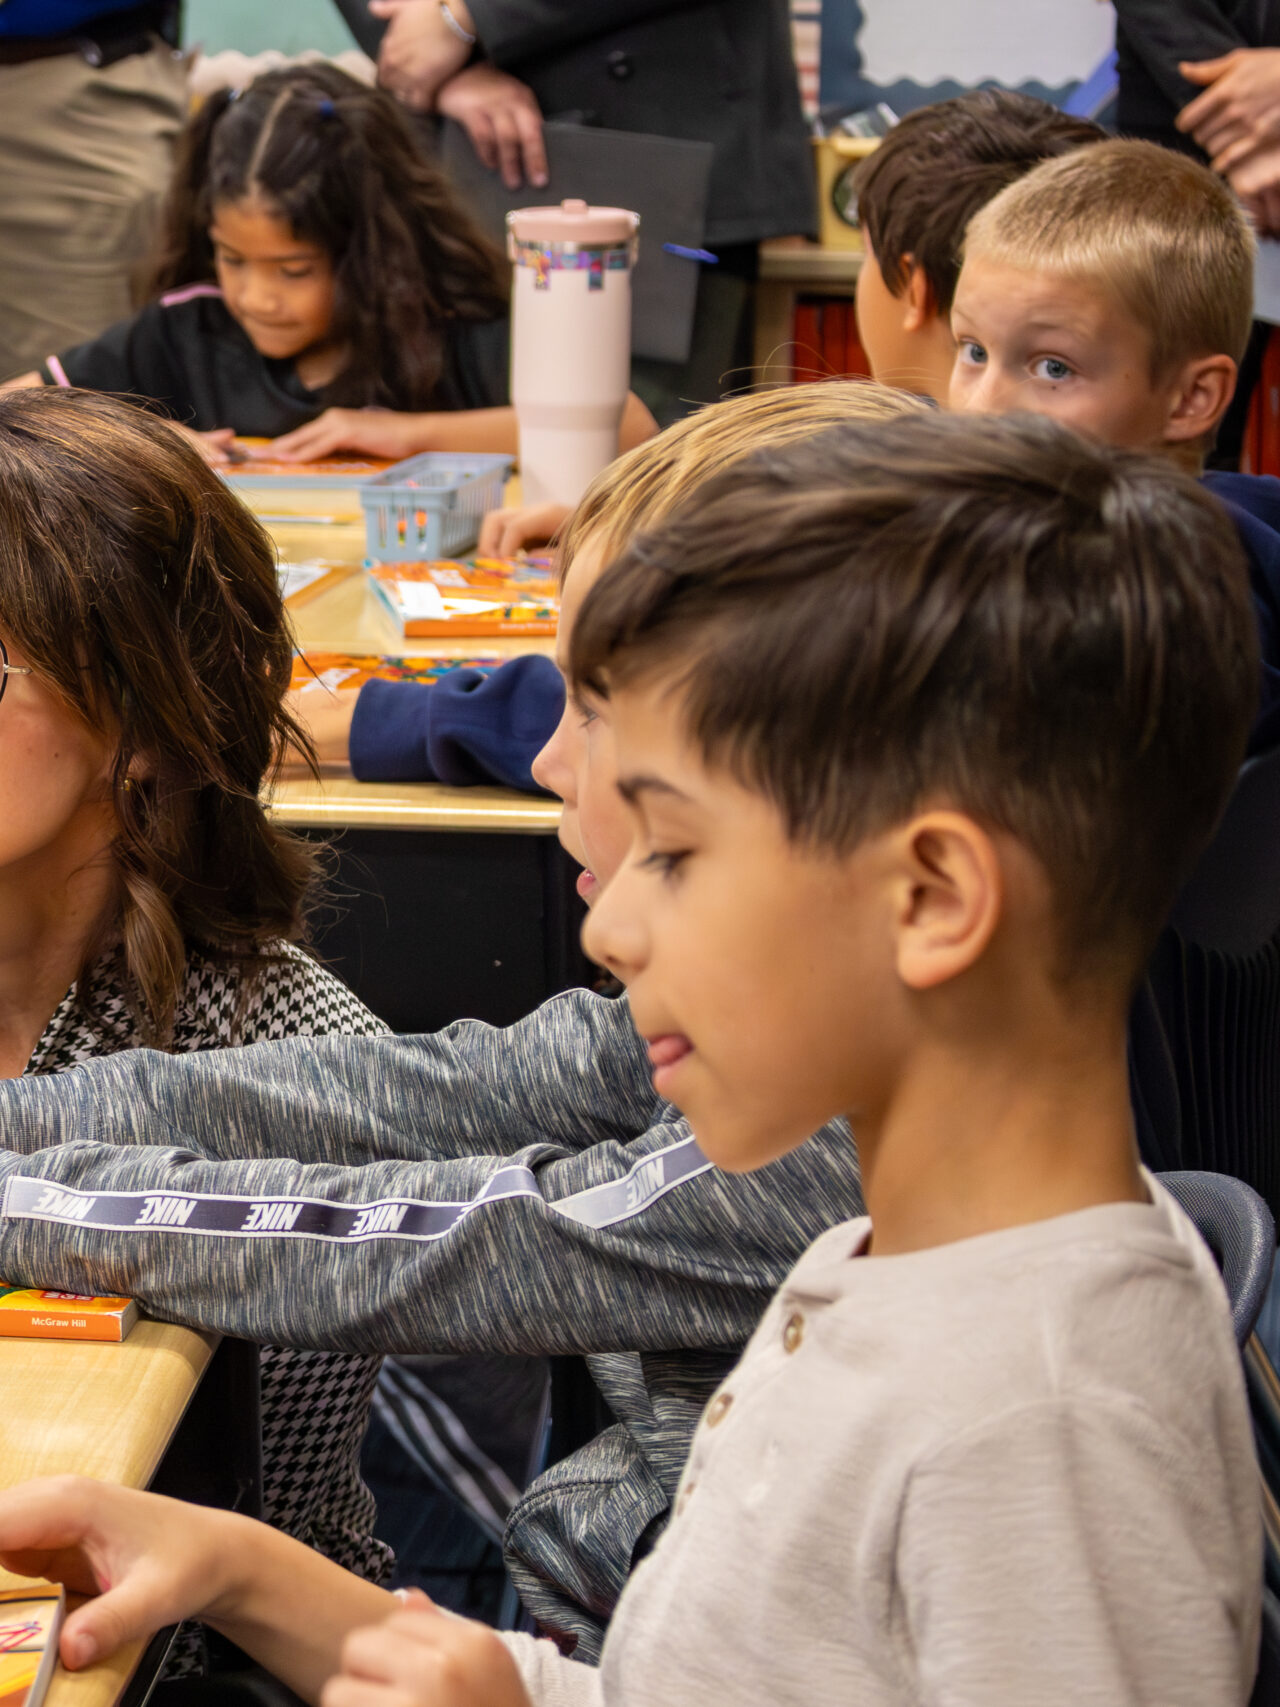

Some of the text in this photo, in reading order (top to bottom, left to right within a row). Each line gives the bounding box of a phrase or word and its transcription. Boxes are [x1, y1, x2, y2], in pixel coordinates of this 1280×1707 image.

[625, 1156, 666, 1211] NIKE
[32, 1187, 97, 1220] NIKE
[135, 1197, 198, 1226] NIKE
[241, 1203, 304, 1231] NIKE
[348, 1204, 409, 1235] NIKE
[32, 1317, 87, 1328] McGraw Hill
